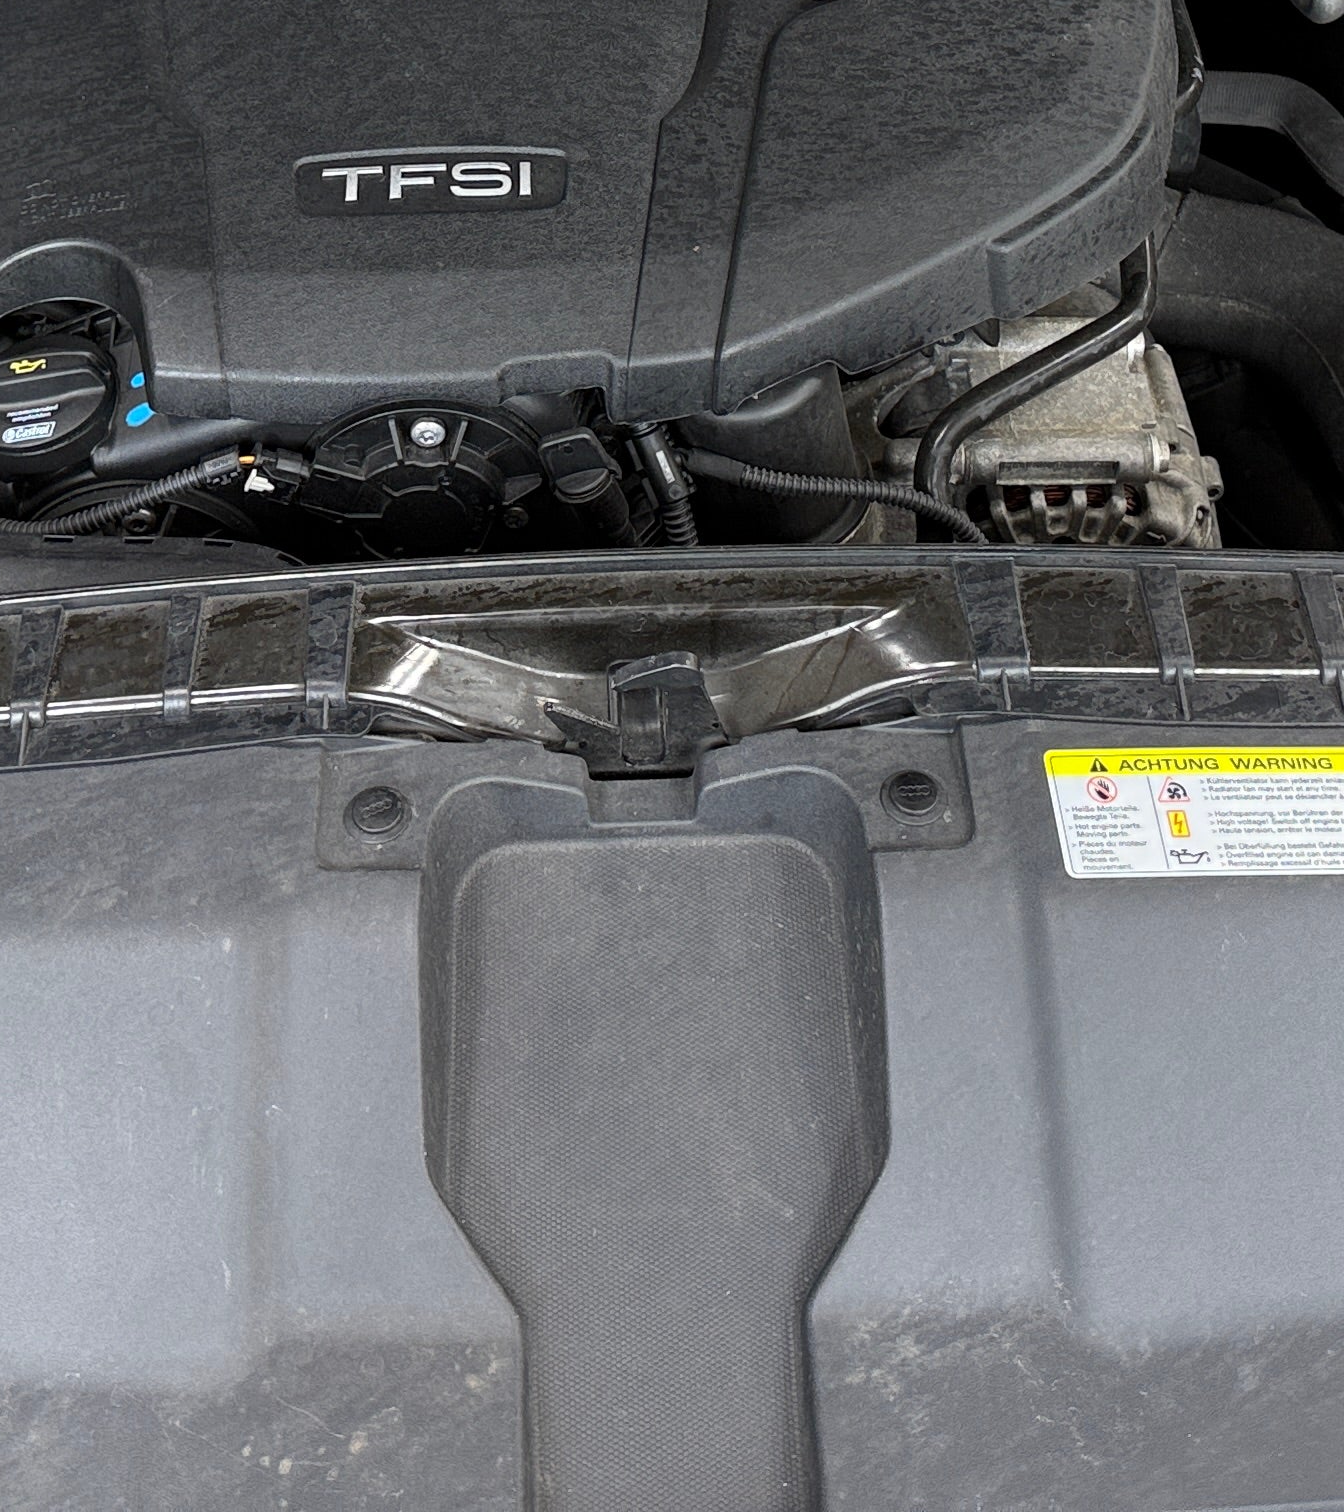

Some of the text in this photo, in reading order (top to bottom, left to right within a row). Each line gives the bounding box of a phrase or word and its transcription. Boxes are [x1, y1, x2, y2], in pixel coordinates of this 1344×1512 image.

[321, 161, 532, 202] TFSI
[16, 423, 52, 439] Castrol
[1118, 758, 1219, 773] ACHTUNG
[1229, 756, 1333, 771] WARNING
[1258, 786, 1275, 794] may
